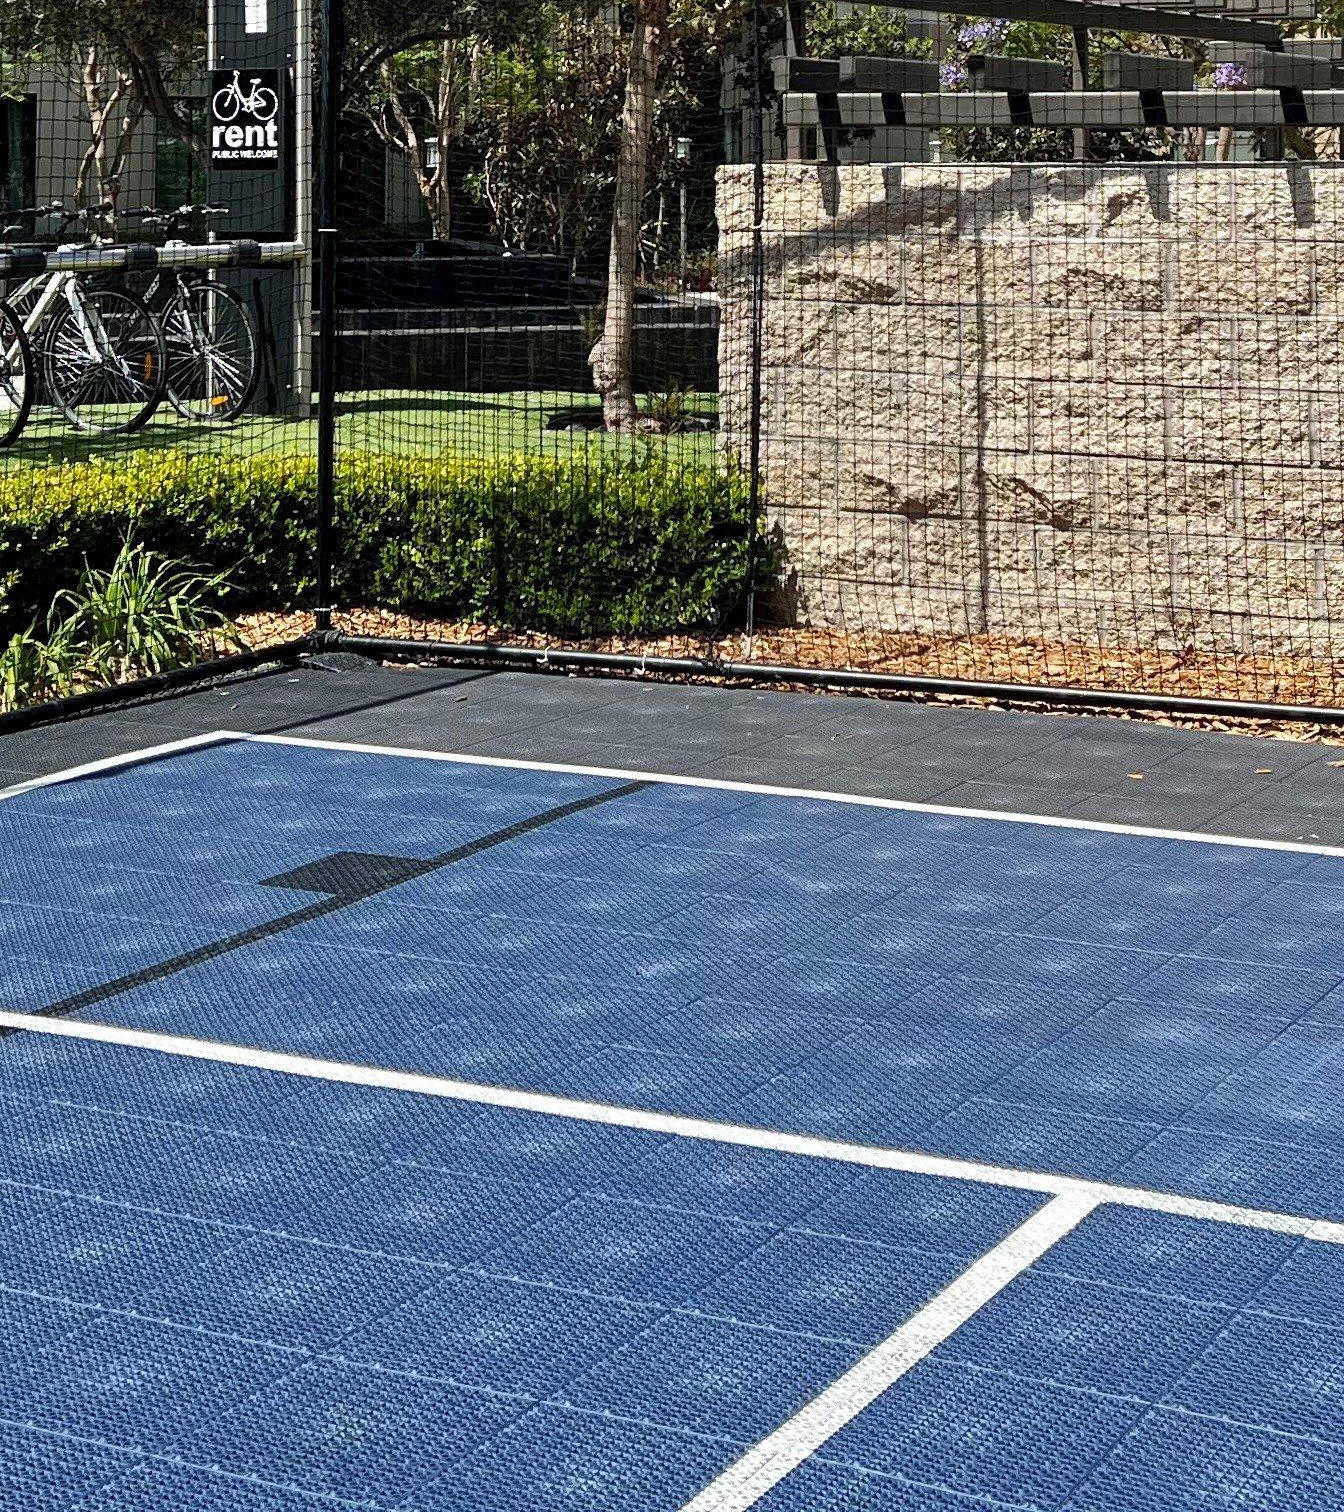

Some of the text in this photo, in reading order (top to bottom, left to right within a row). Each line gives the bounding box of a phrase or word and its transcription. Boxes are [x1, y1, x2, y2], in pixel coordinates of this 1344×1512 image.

[212, 119, 278, 147] rent
[212, 150, 278, 158] PUBLIC WELCOME
